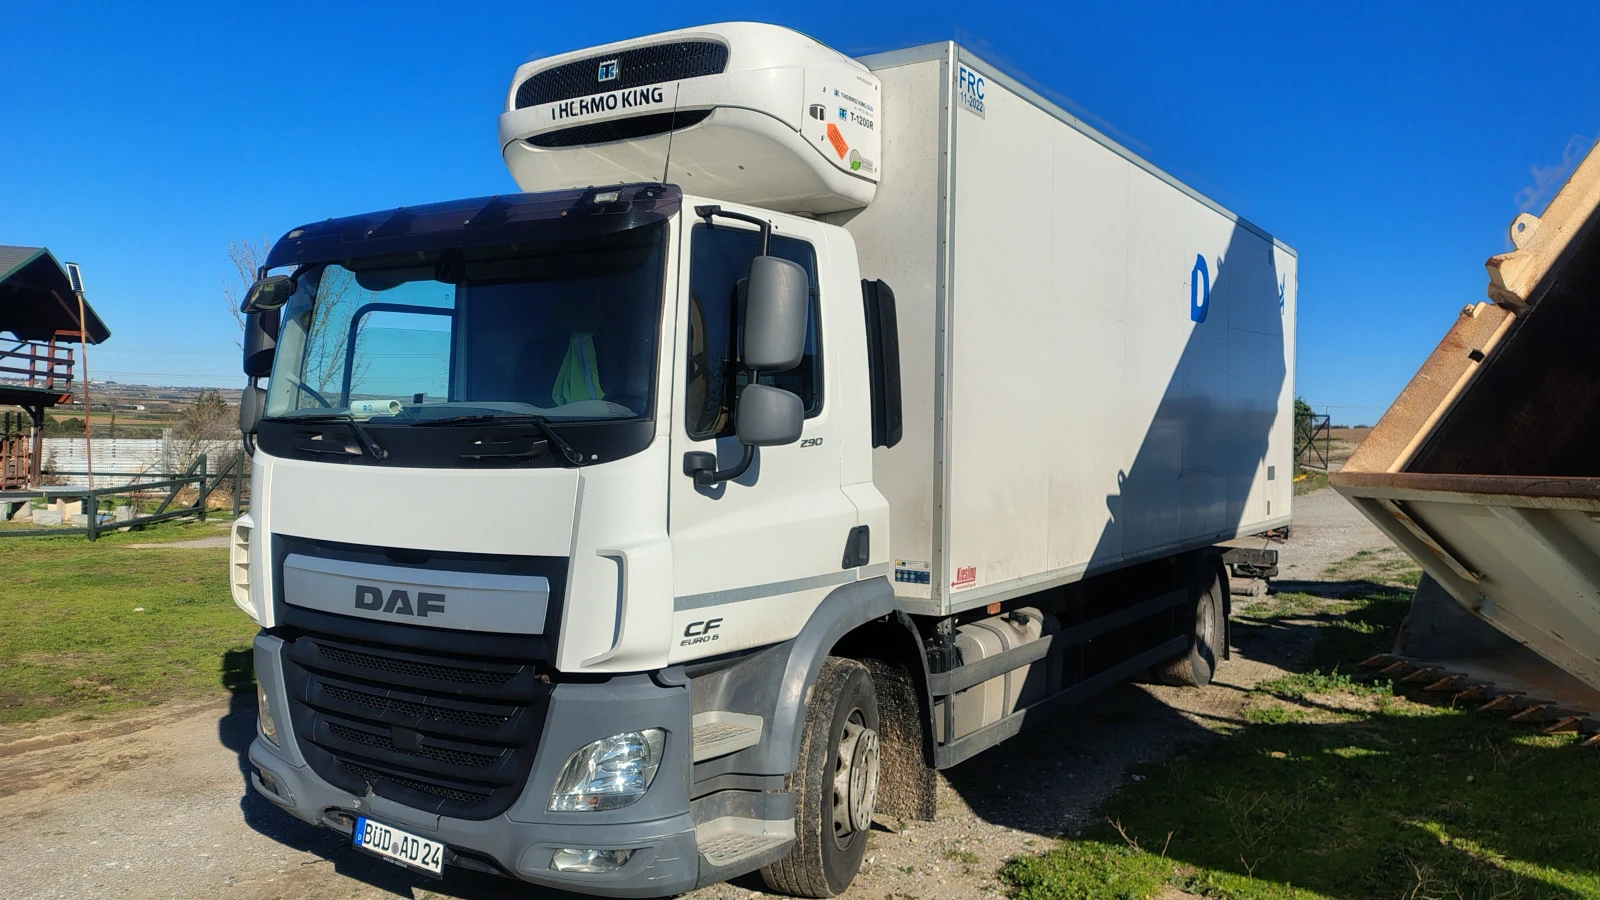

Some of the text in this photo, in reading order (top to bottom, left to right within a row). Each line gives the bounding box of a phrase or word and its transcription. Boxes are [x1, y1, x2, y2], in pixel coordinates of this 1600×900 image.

[959, 66, 985, 100] FRC
[621, 87, 663, 108] KING
[960, 90, 984, 113] 11-2022
[850, 112, 874, 131] T-1200R
[800, 436, 823, 448] 290
[354, 584, 446, 617] DAF
[683, 617, 724, 638] CF
[680, 635, 711, 647] EURO
[363, 823, 392, 852] BÜD
[399, 835, 420, 861] AD
[421, 842, 441, 869] 24
